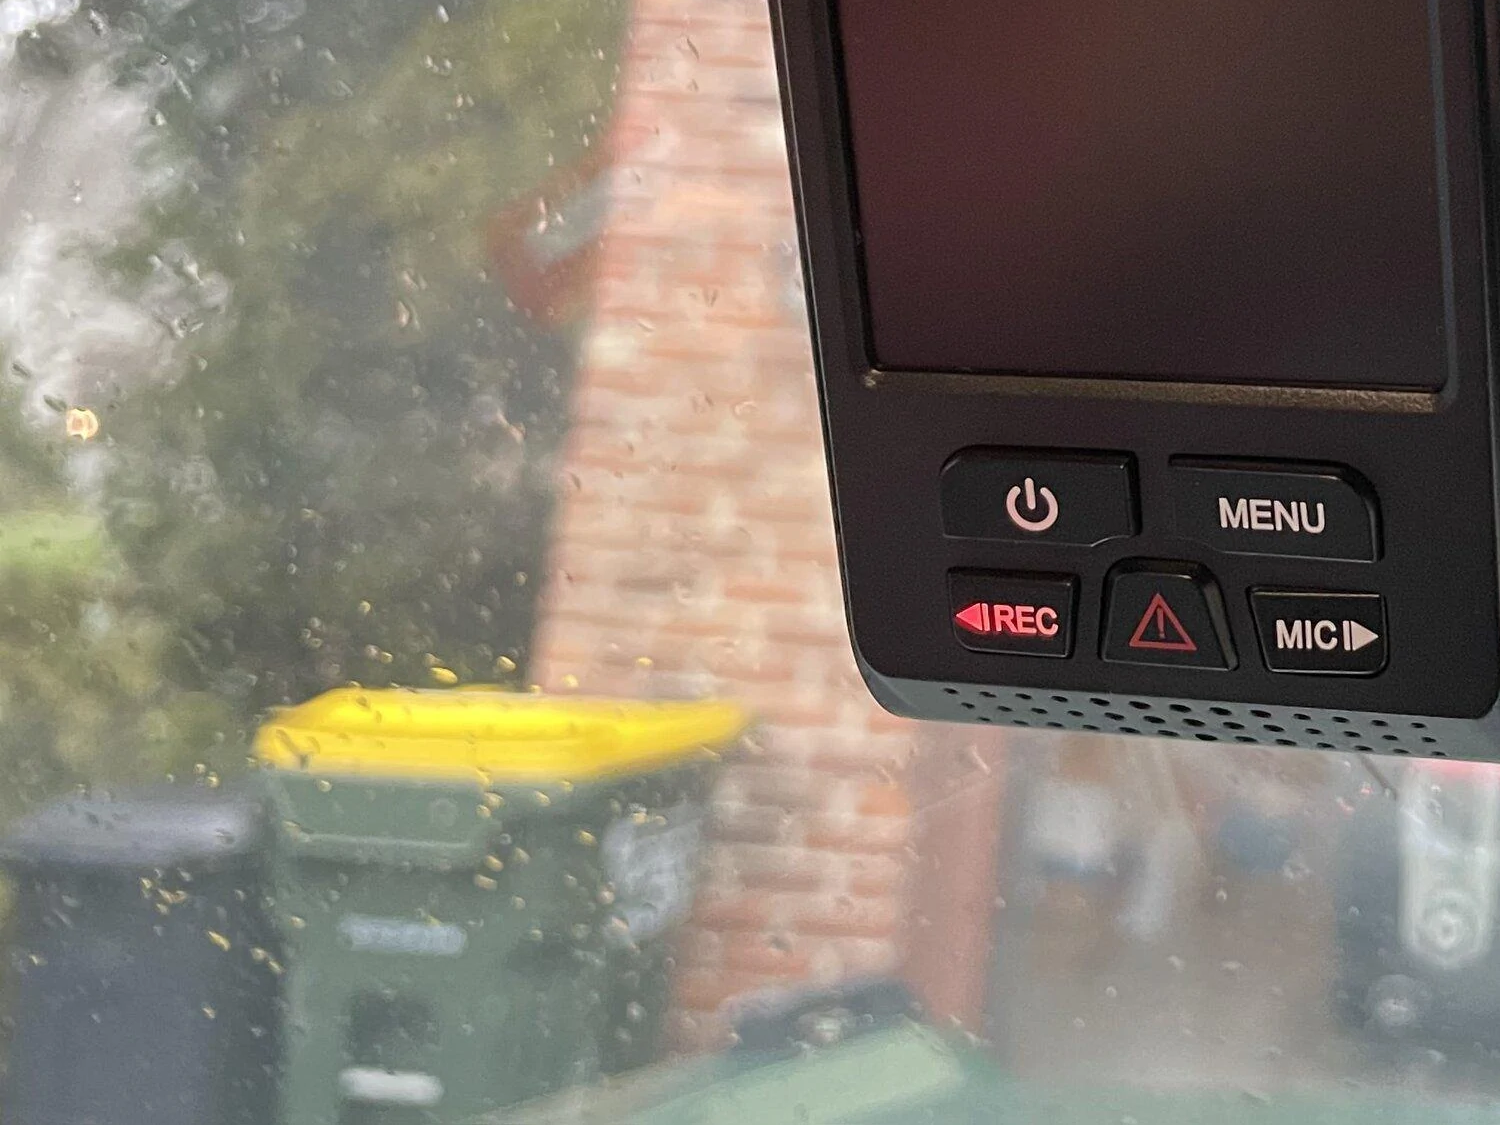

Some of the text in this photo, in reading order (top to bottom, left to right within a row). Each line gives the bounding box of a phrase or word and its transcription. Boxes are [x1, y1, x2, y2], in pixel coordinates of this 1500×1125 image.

[1218, 497, 1326, 534] MENU
[994, 604, 1059, 636] REC
[1276, 619, 1338, 651] MIC
